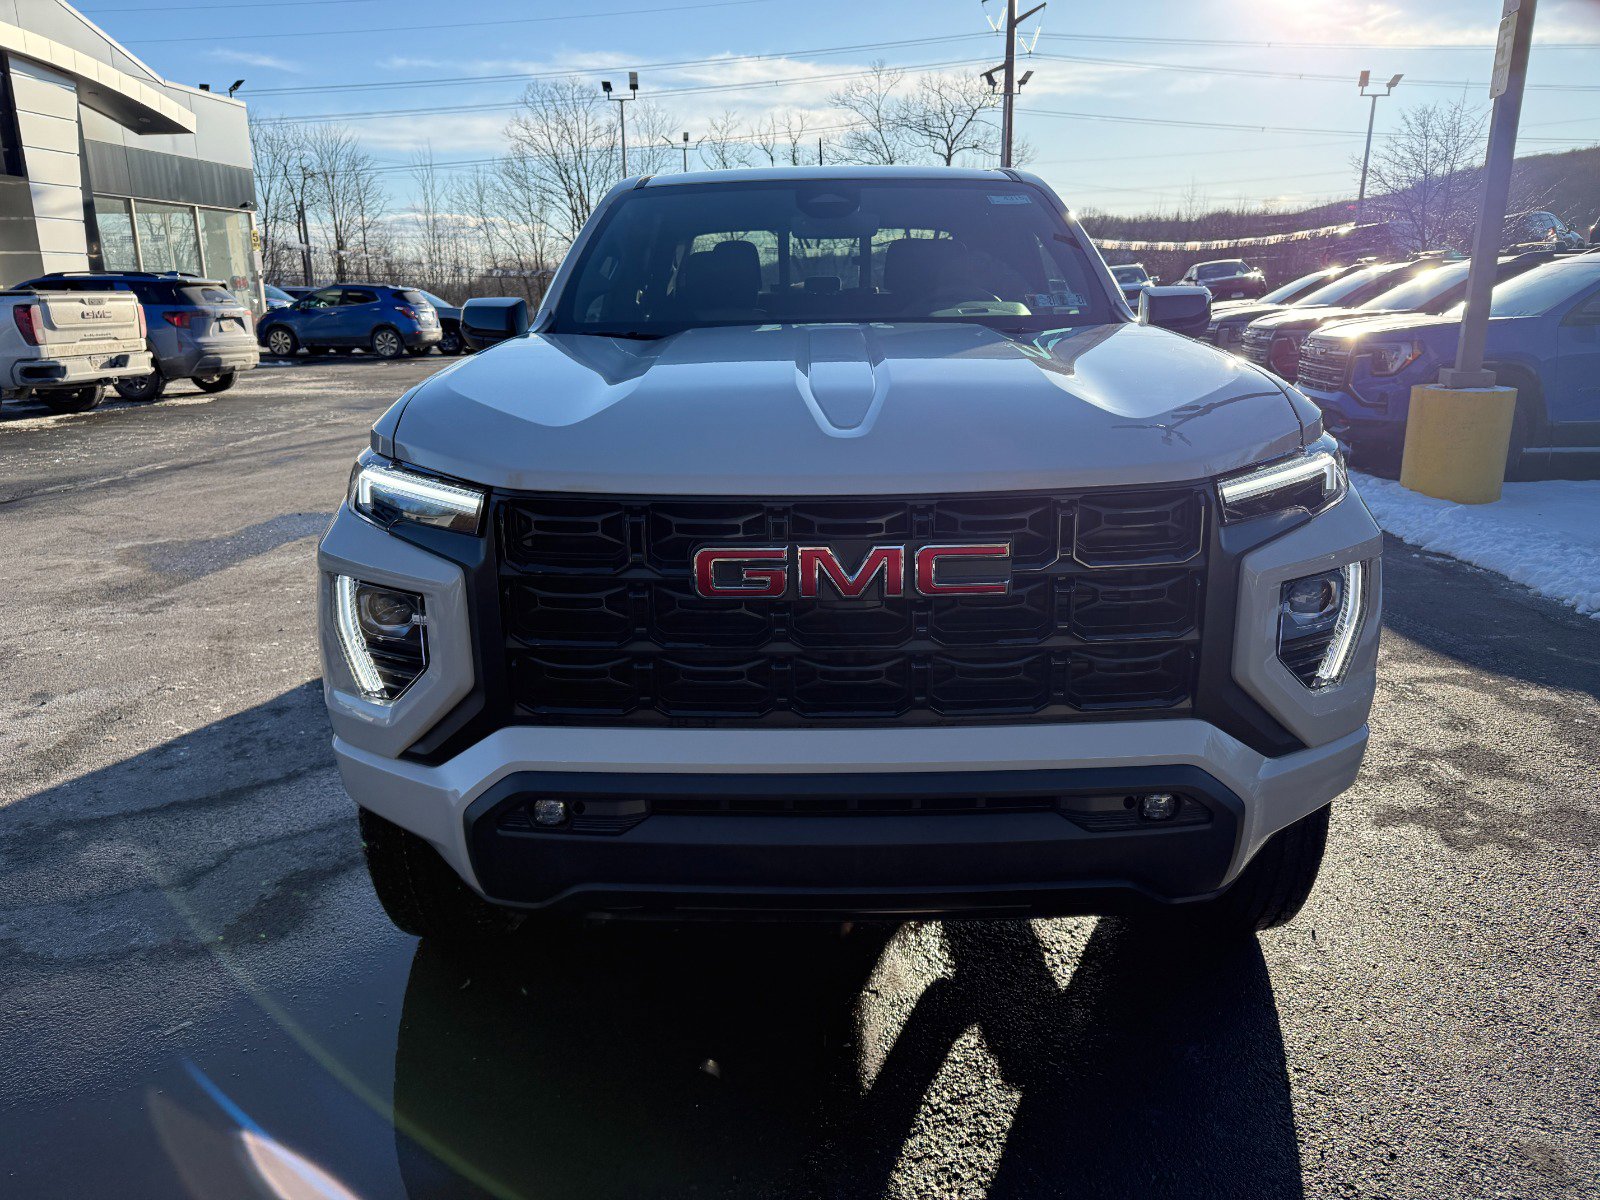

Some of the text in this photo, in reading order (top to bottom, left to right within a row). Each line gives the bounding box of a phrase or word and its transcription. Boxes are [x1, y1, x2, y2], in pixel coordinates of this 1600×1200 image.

[252, 232, 259, 243] 5
[81, 309, 112, 319] GMC
[693, 542, 1010, 598] GMC
